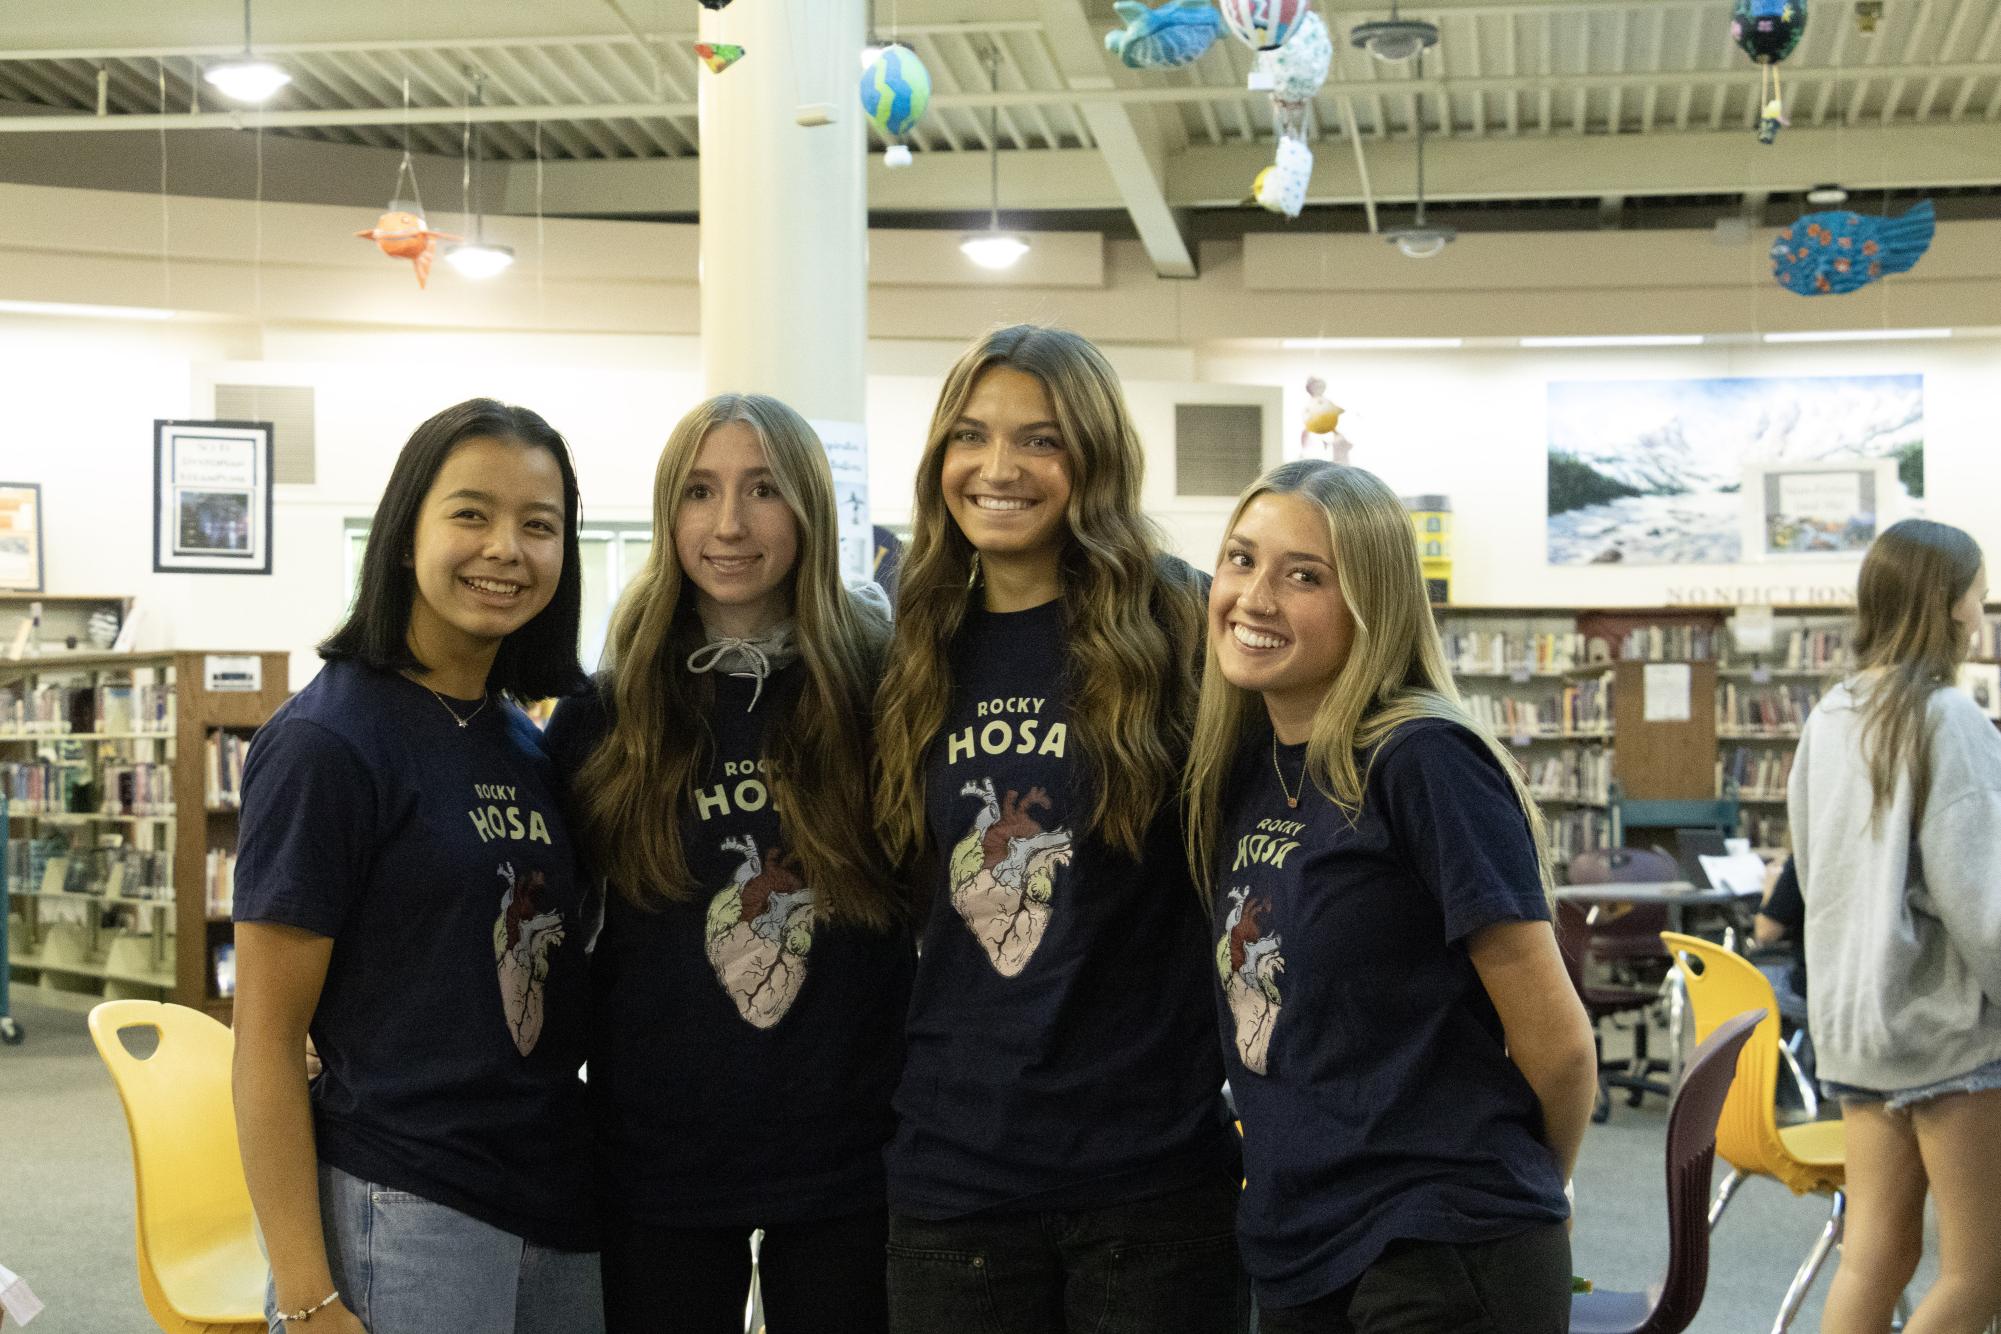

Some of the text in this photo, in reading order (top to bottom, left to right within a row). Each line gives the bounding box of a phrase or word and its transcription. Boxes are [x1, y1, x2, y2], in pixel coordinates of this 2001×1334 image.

[977, 697, 1046, 717] ROCKY
[948, 719, 1067, 765] HOSA
[724, 759, 781, 777] ROC
[474, 784, 516, 801] ROCKY
[694, 779, 781, 821] HO
[467, 805, 552, 845] HOSA
[1256, 818, 1307, 837] ROCKY
[1232, 834, 1302, 872] HOSA
